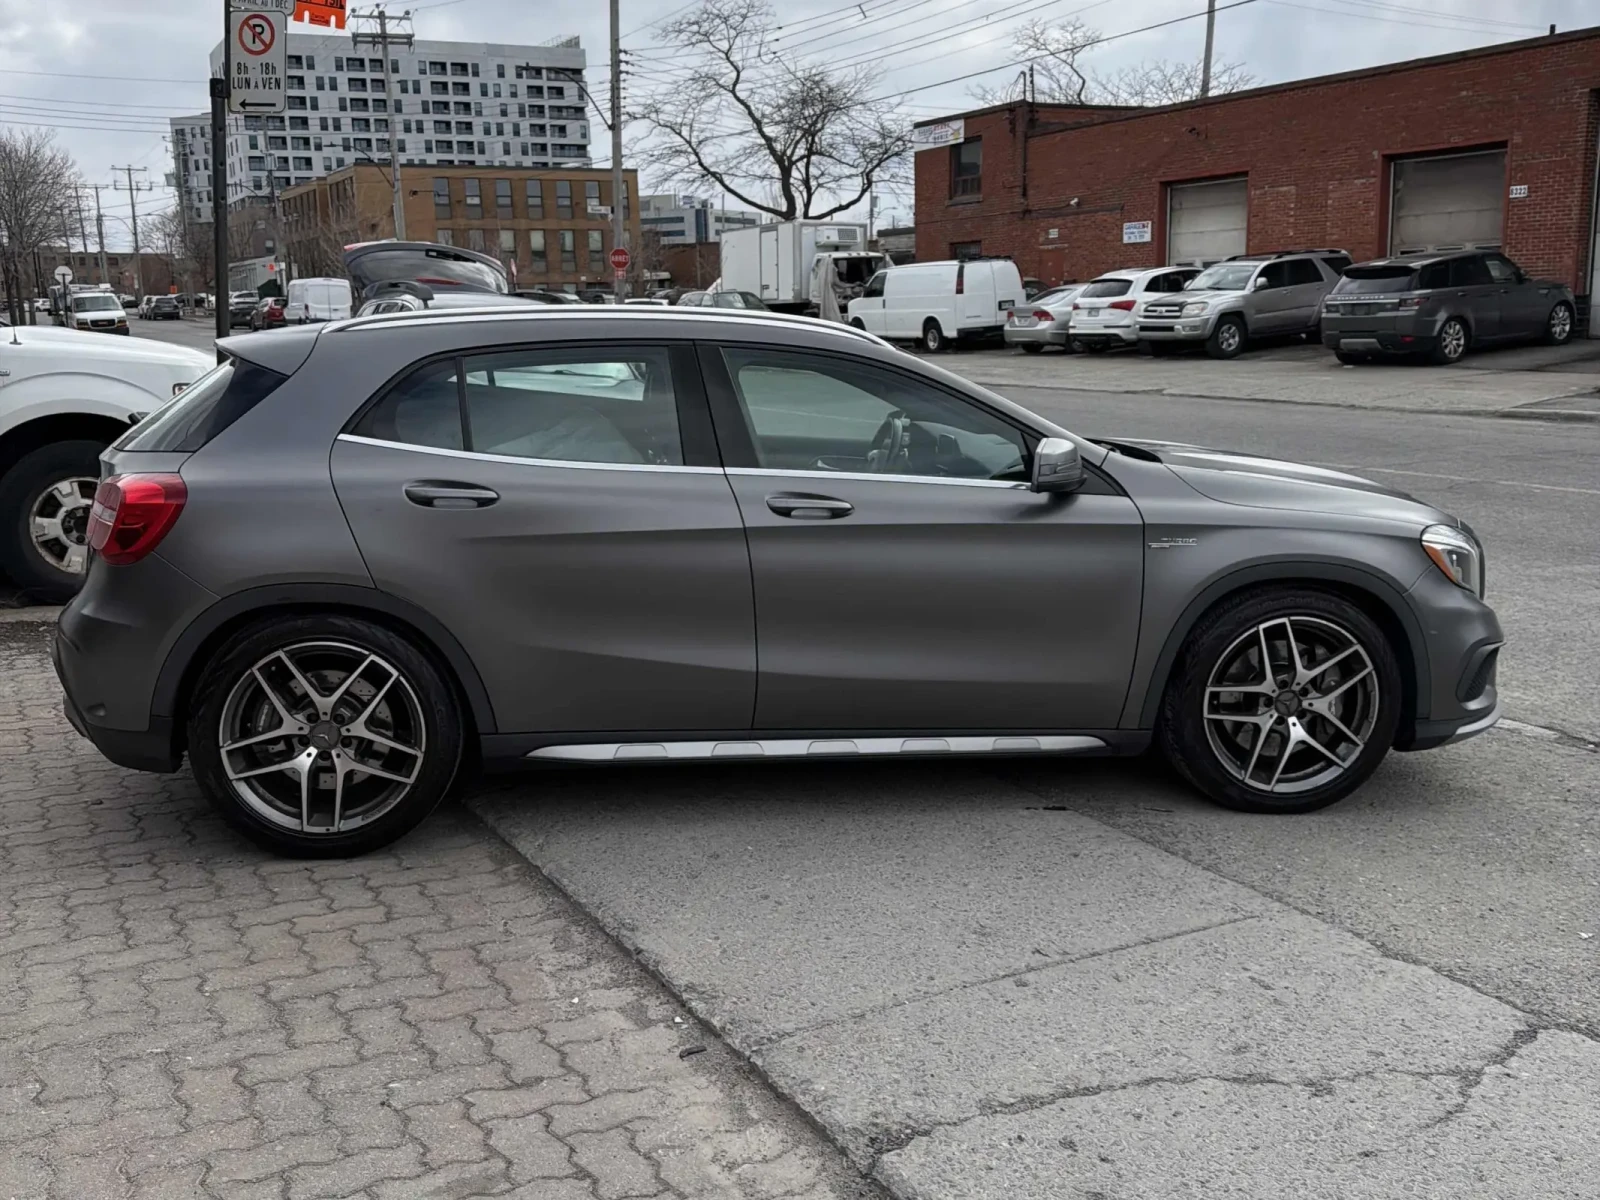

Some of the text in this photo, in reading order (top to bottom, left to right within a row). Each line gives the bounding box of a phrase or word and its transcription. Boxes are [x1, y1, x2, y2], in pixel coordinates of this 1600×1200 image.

[236, 61, 249, 75] 8h
[260, 61, 276, 75] 18h
[232, 77, 251, 90] LUN
[261, 77, 281, 90] VEN
